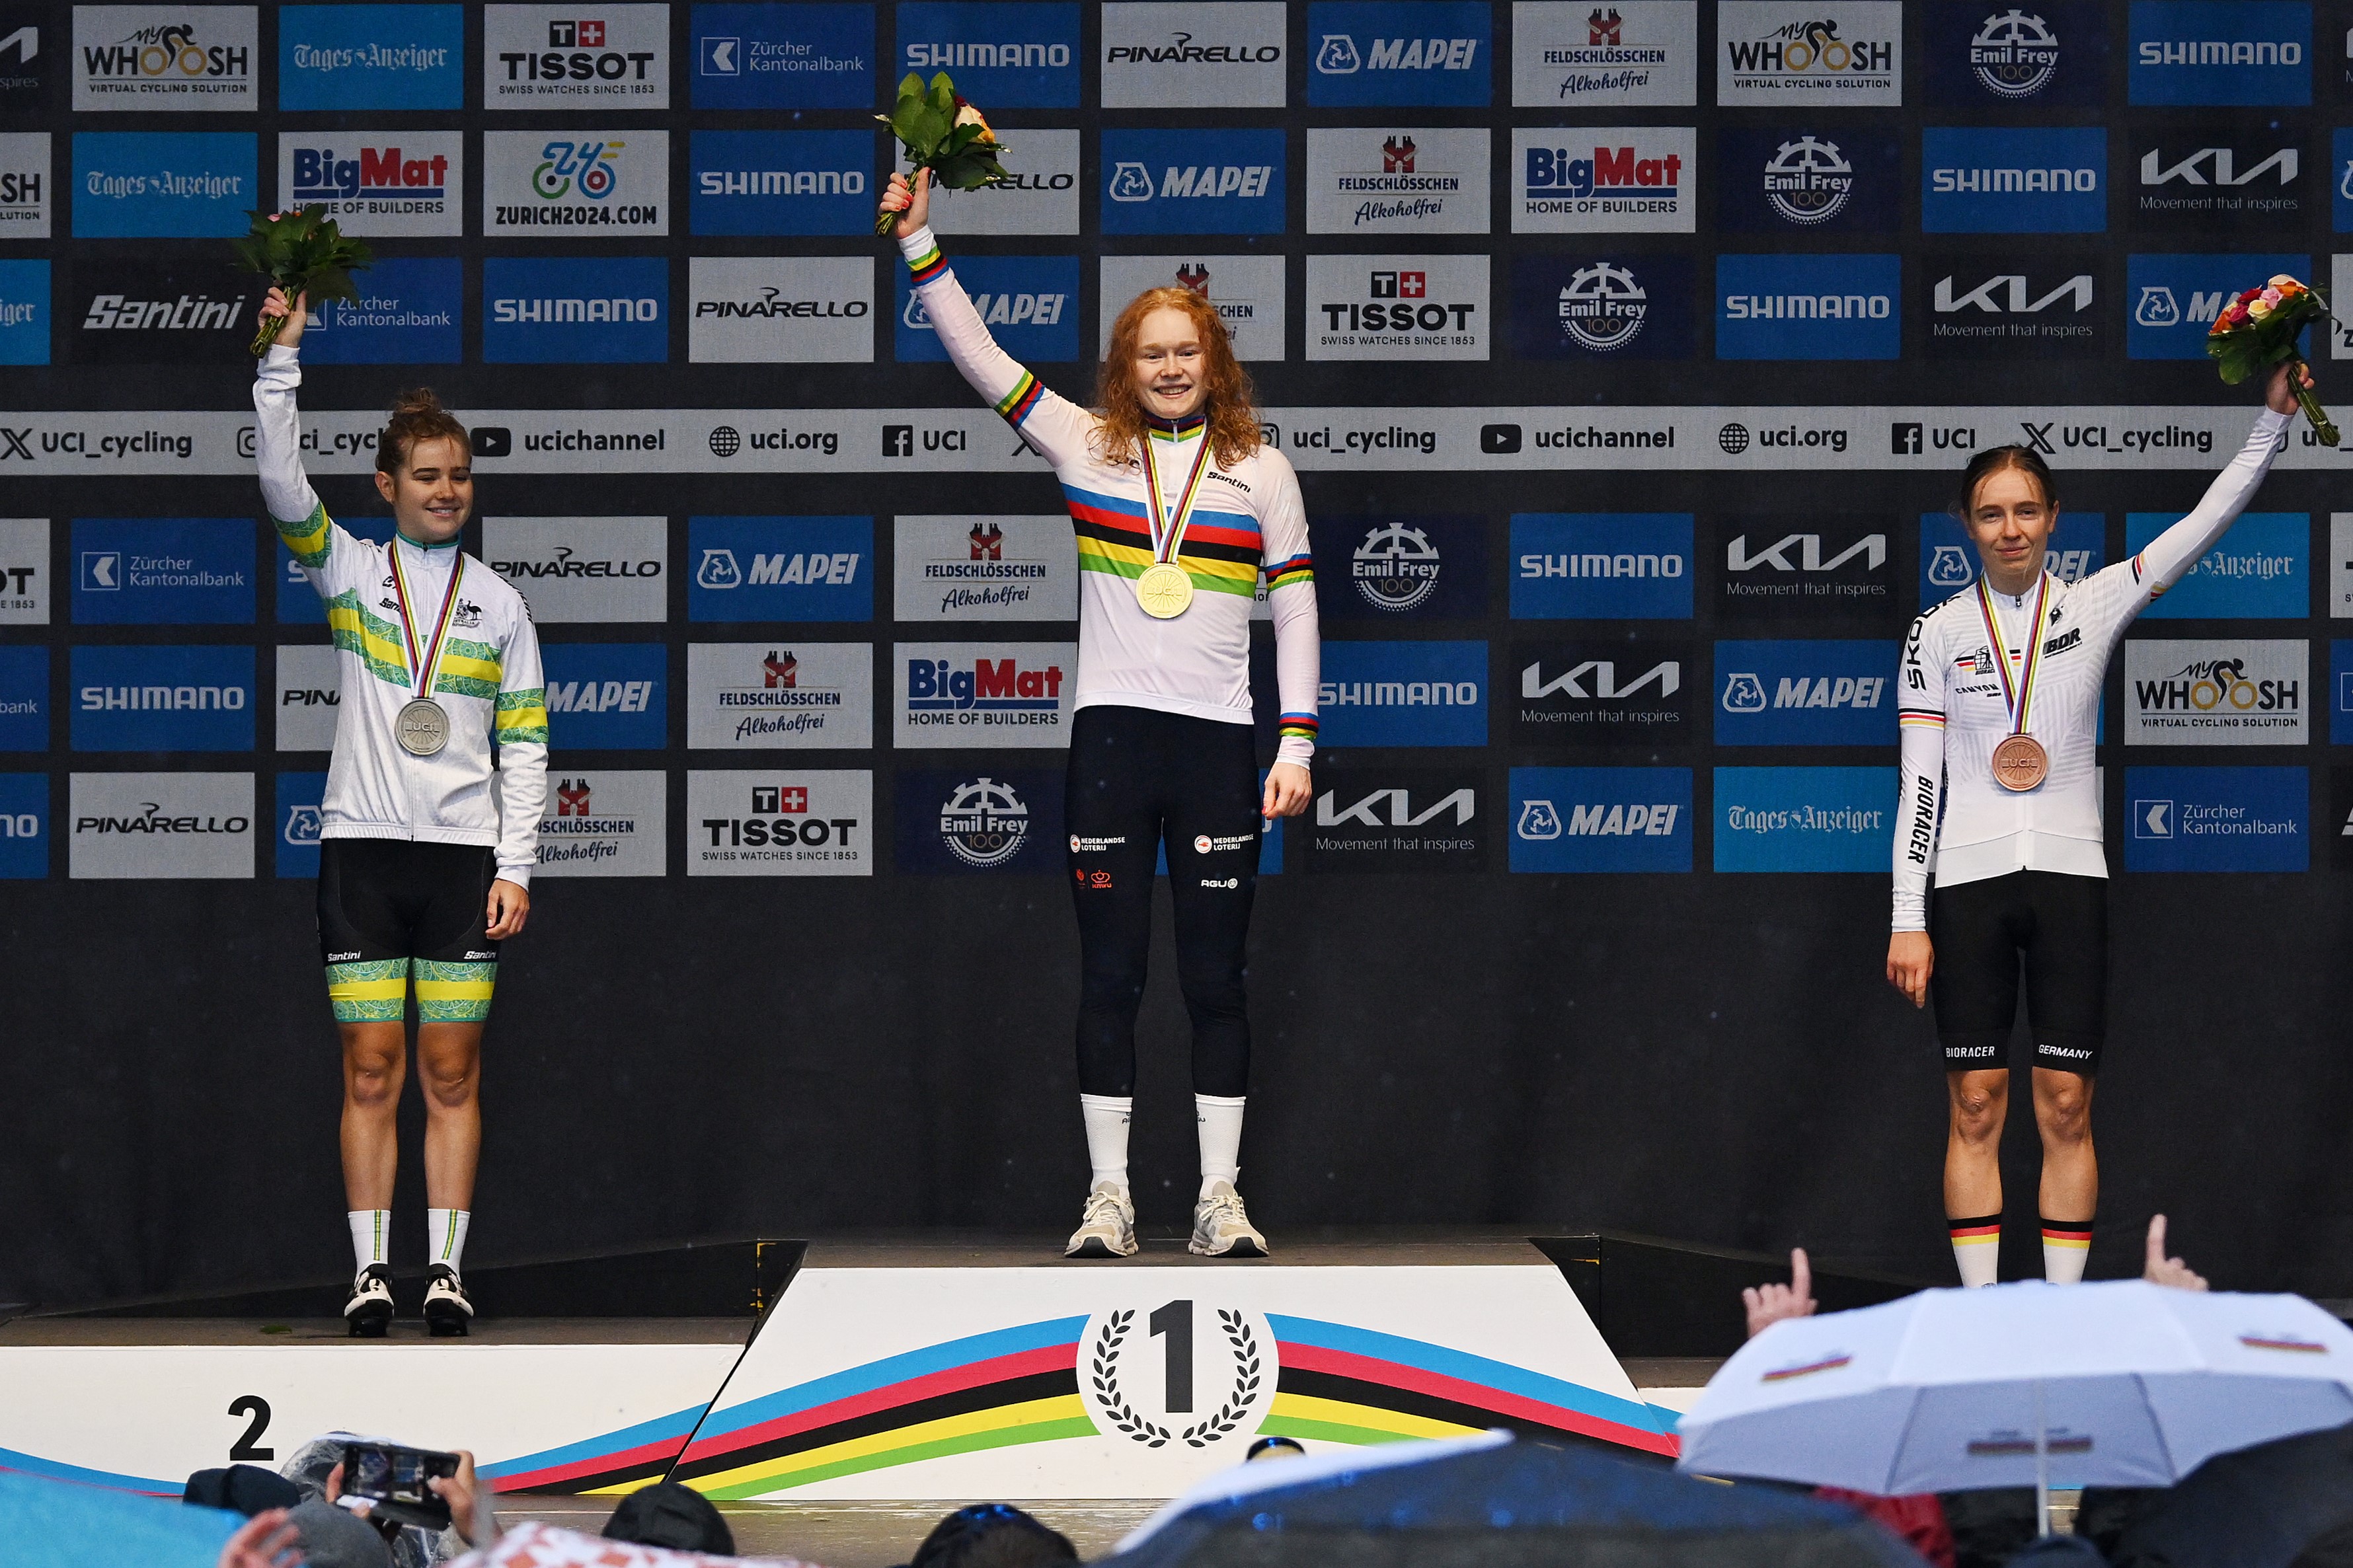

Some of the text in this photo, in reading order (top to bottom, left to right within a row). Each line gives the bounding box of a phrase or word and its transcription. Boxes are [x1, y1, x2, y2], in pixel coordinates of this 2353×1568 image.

[294, 42, 448, 69] Tages Anzeiger
[750, 41, 812, 56] Zürcher
[907, 44, 1070, 67] SHIMANO
[1108, 46, 1280, 63] PINARELLO
[1368, 38, 1478, 70] MAPEI
[1544, 48, 1665, 63] FELDSCHLÖSSCHEN
[1728, 41, 1891, 71] WHOOSH
[1971, 48, 2058, 67] Emil Frey
[2140, 42, 2301, 65] SHIMANO
[85, 45, 247, 77] WHOOSH
[500, 52, 654, 80] TISSOT
[750, 56, 864, 71] Kantonalbank
[1997, 65, 2033, 80] 100
[192, 84, 247, 93] SOLUTION
[500, 85, 654, 94] SWISS WATCHES SINCE 1853
[1560, 71, 1649, 98] Alkoholfrei
[1734, 79, 1891, 88] VIRTUAL CYCLING SOLUTION
[293, 148, 448, 198] BigMat
[1527, 147, 1681, 197] BigMat
[2141, 148, 2297, 185] KIA
[87, 170, 241, 198] Tages Anzeiger
[701, 171, 865, 194] SHIMANO
[1162, 167, 1271, 197] MAPEI
[1338, 175, 1458, 191] FELDSCHLÖSSCHEN
[1765, 174, 1852, 193] Emil Frey
[1933, 169, 2096, 192] SHIMANO
[293, 202, 444, 213] HE OF BUILDERS
[1526, 202, 1678, 213] HOME OF BUILDERS
[1790, 192, 1826, 206] 100
[2141, 196, 2297, 213] Movement that inspires
[496, 205, 657, 225] ZURICH2024.COM
[1355, 199, 1442, 225] Alkoholfrei
[1934, 275, 2093, 313] KIA
[84, 295, 245, 329] Santini
[494, 299, 657, 322] SHIMANO
[695, 301, 867, 318] PINARELLO
[1559, 301, 1646, 319] Emil Frey
[1726, 295, 1890, 318] SHIMANO
[336, 311, 451, 326] Kantonalbank
[1322, 304, 1475, 331] TISSOT
[1585, 318, 1621, 333] 100
[1414, 336, 1447, 345] SINCE
[1451, 336, 1475, 345] 1853
[1934, 324, 2093, 339] Movement that inspires
[42, 432, 192, 459] UCI_cycling
[299, 428, 383, 455] ci_cycl
[525, 429, 664, 451] ucichannel
[750, 429, 838, 454] uci.org
[923, 431, 966, 451] UCI
[1293, 428, 1436, 453] uci_cycling
[1535, 428, 1674, 448] ucichannel
[1760, 426, 1847, 451] uci.org
[1932, 429, 1976, 448] UCI
[2064, 427, 2212, 452] UCI_cycling
[1207, 471, 1251, 493] Santini
[1728, 534, 1886, 571] KIA
[130, 556, 192, 571] Zürcher
[490, 561, 660, 578] PINARELLO
[748, 554, 859, 585] MAPEI
[926, 564, 1046, 578] FELDSCHLÖSSCHEN
[1353, 561, 1440, 579] Emil Frey
[1520, 554, 1682, 578] SHIMANO
[2043, 550, 2090, 581] PEI
[2211, 552, 2294, 578] Anzeiger
[130, 572, 244, 587] Kantonalbank
[1378, 578, 1414, 593] 100
[1727, 581, 1886, 597] Movement that inspires
[10, 600, 34, 609] 1853
[943, 586, 1029, 612] Alkoholfrei
[909, 659, 1062, 710] BigMat
[1523, 661, 1679, 698] KIA
[1955, 683, 1999, 694] CANYON
[81, 687, 245, 710] SHIMANO
[545, 681, 652, 712] MAPEI
[720, 691, 841, 706] FELDSCHLÖSSCHEN
[1317, 683, 1478, 706] SHIMANO
[1774, 677, 1884, 708] MAPEI
[2136, 680, 2298, 710] WHOOSH
[413, 722, 432, 731] UCI
[736, 714, 824, 740] Alkoholfrei
[908, 713, 1058, 725] HOME OF BUILDERS
[1522, 709, 1679, 726] Movement that inspires
[2192, 718, 2239, 727] CYCLING
[2243, 718, 2297, 727] SOLUTION
[1317, 789, 1474, 826] KIA
[2184, 805, 2245, 818] Zürcher
[76, 817, 248, 833] PINARELLO
[537, 819, 634, 833] SCHLÖSSCHEN
[941, 816, 1028, 835] Emil Frey
[1569, 804, 1678, 835] MAPEI
[1729, 805, 1882, 833] Tages Anzeiger
[1908, 775, 1934, 864] BIORACER
[2184, 820, 2297, 835] Kantonalbank
[703, 819, 857, 846] TISSOT
[966, 833, 1003, 849] 100
[1214, 834, 1254, 844] NEDERLANDSE
[1317, 837, 1475, 852] Movement that inspires
[328, 951, 362, 961] Santini
[464, 951, 496, 959] Santin
[1946, 1046, 1995, 1057] BIORACER
[2038, 1044, 2093, 1059] GERMANY
[1150, 1299, 1193, 1413] 1
[227, 1395, 275, 1462] 2
